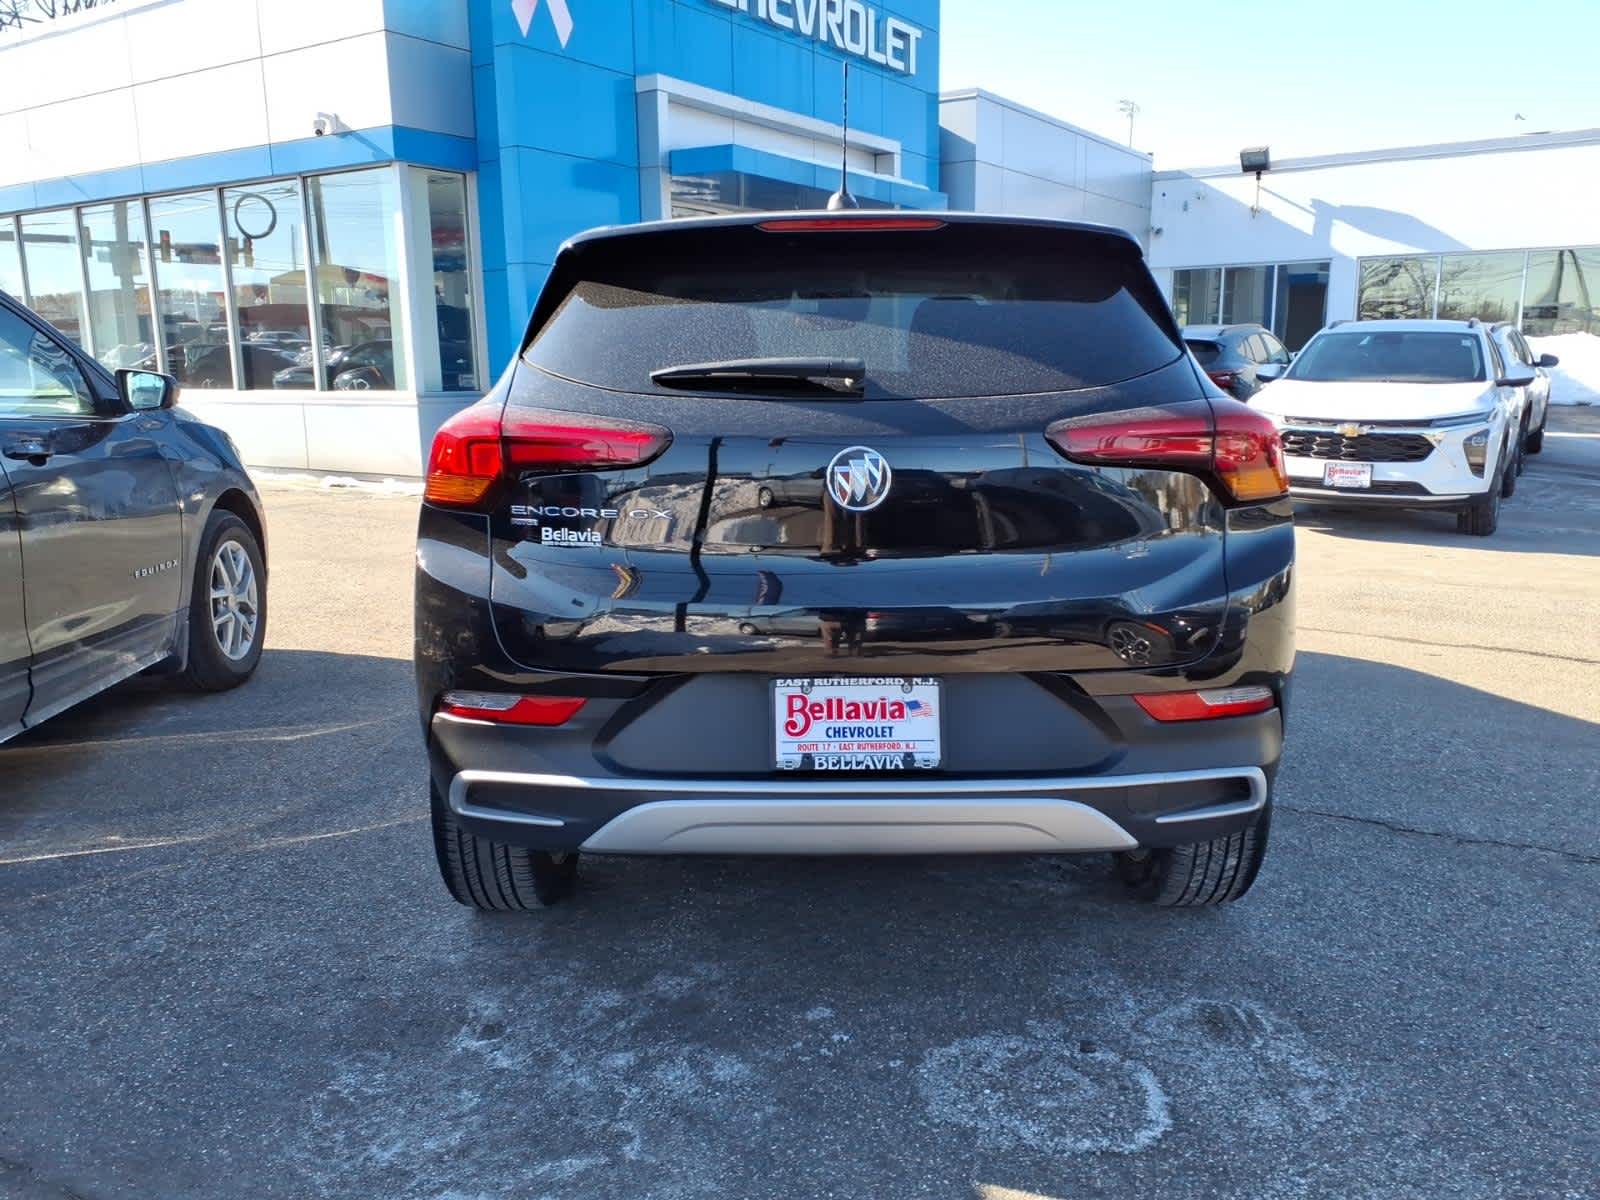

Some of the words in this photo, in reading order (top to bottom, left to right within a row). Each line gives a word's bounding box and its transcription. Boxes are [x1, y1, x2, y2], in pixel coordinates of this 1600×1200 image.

[715, 0, 923, 76] EVROLET
[510, 505, 618, 519] ENCORE
[629, 509, 673, 520] GX
[541, 527, 602, 542] Bellavia
[776, 678, 811, 687] EAST
[912, 678, 939, 687] N.J.
[784, 693, 905, 738] Bellavia
[825, 726, 895, 739] CHEVROLET
[797, 743, 819, 752] ROUTE
[822, 743, 831, 752] 17
[838, 743, 854, 751] EAST
[814, 755, 904, 770] BELLAVIA
